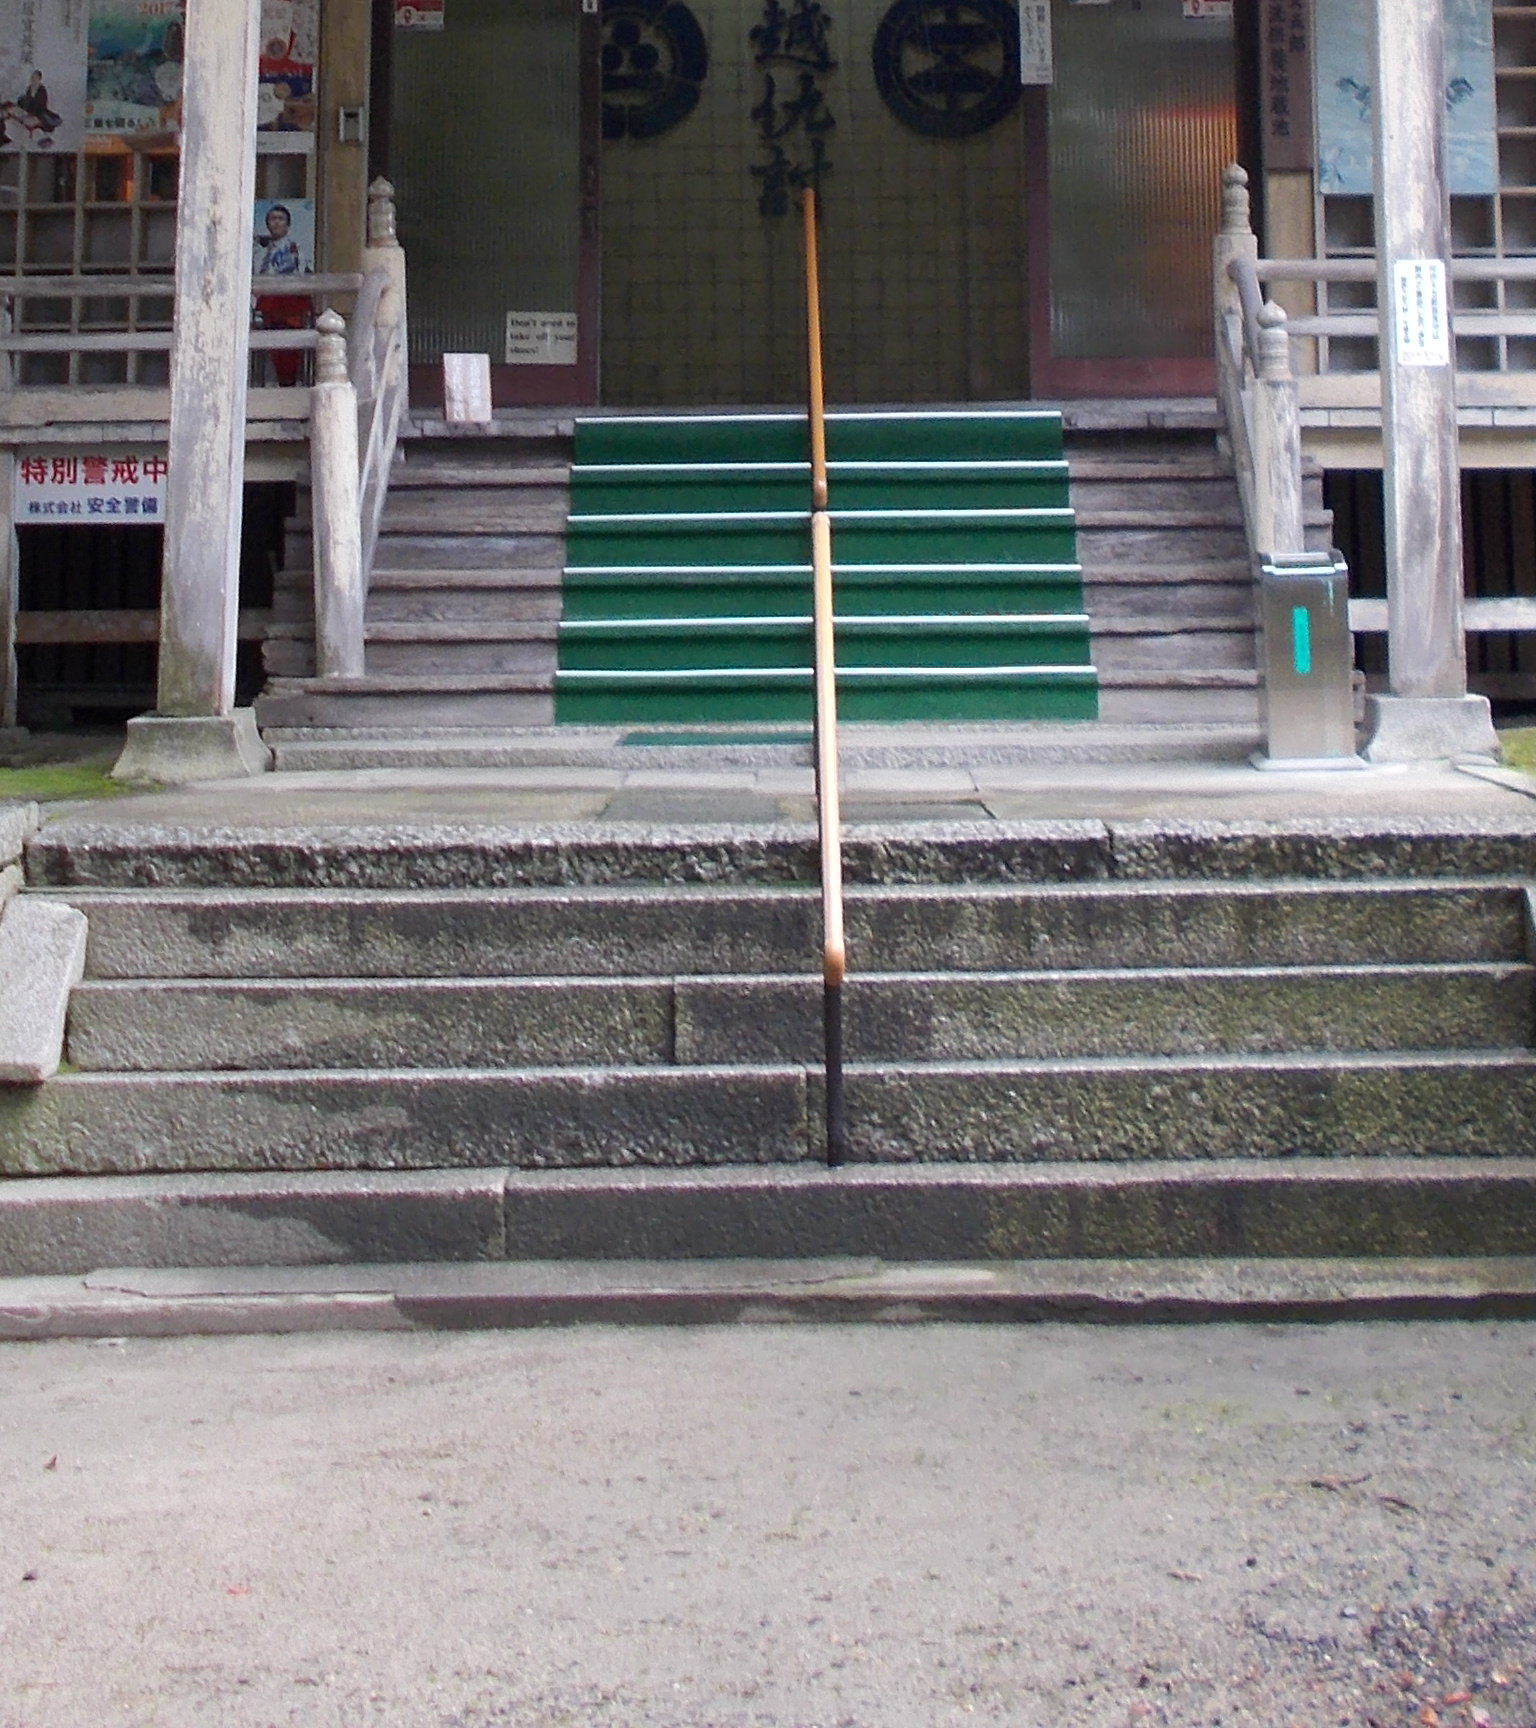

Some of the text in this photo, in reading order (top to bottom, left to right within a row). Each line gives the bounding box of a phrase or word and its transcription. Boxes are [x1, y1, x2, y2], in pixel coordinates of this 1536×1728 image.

[20, 455, 169, 485] 特別警戒中
[28, 499, 82, 514] 株式会社
